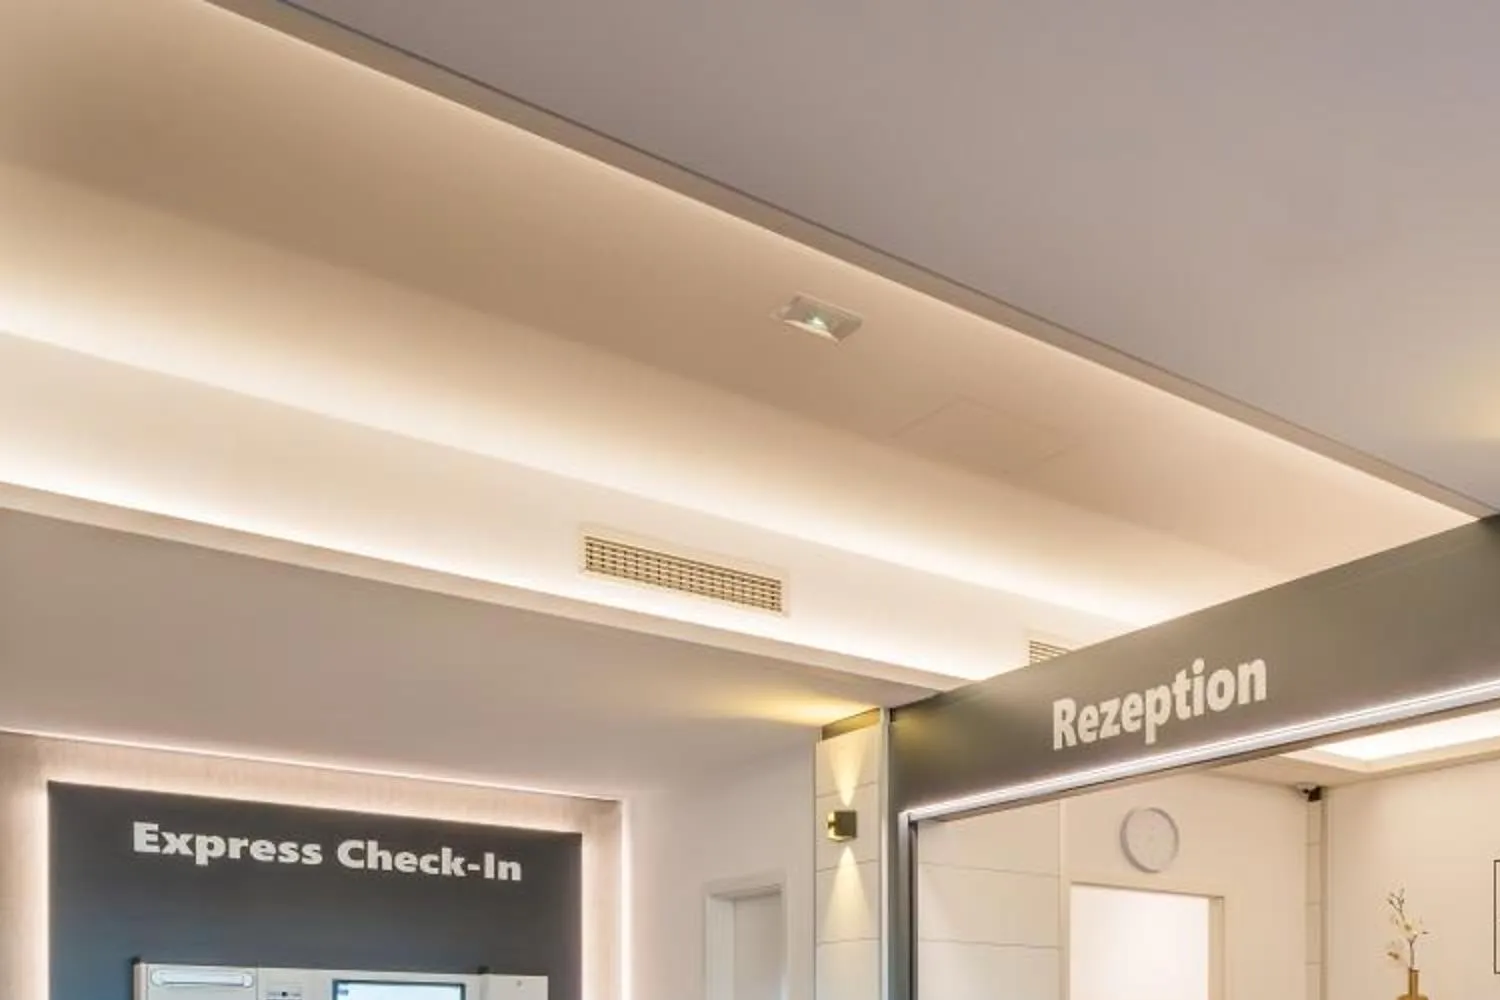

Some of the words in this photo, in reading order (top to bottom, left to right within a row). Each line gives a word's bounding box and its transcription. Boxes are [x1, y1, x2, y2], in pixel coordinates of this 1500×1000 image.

[1053, 658, 1267, 750] Rezeption
[132, 820, 323, 866] Express
[336, 838, 523, 882] Check-In
